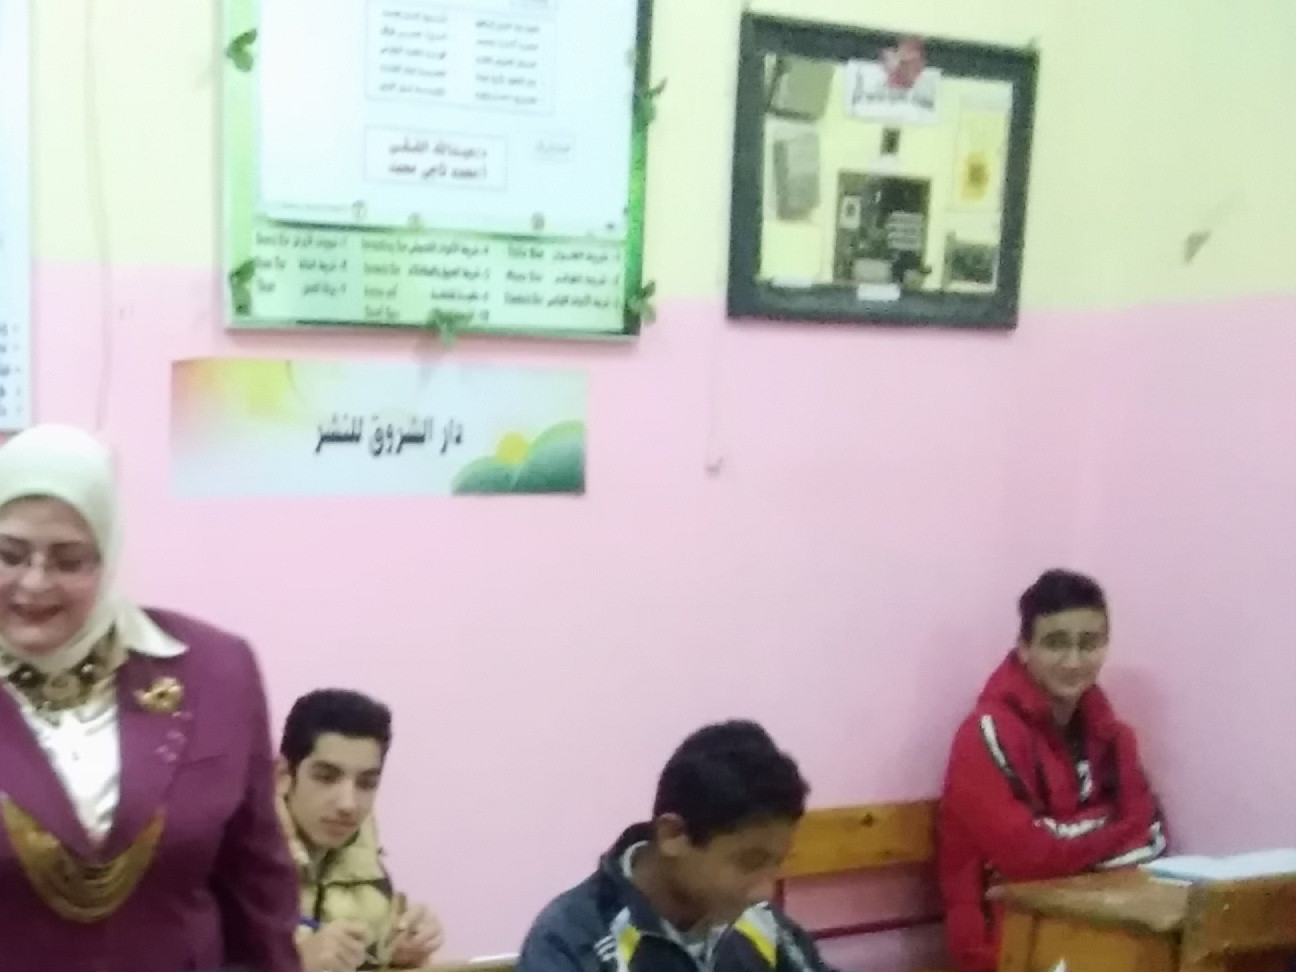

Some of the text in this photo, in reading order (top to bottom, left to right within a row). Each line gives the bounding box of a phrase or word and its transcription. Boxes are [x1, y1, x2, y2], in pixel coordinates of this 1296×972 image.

[314, 412, 464, 459] دار الشروق للنشر
